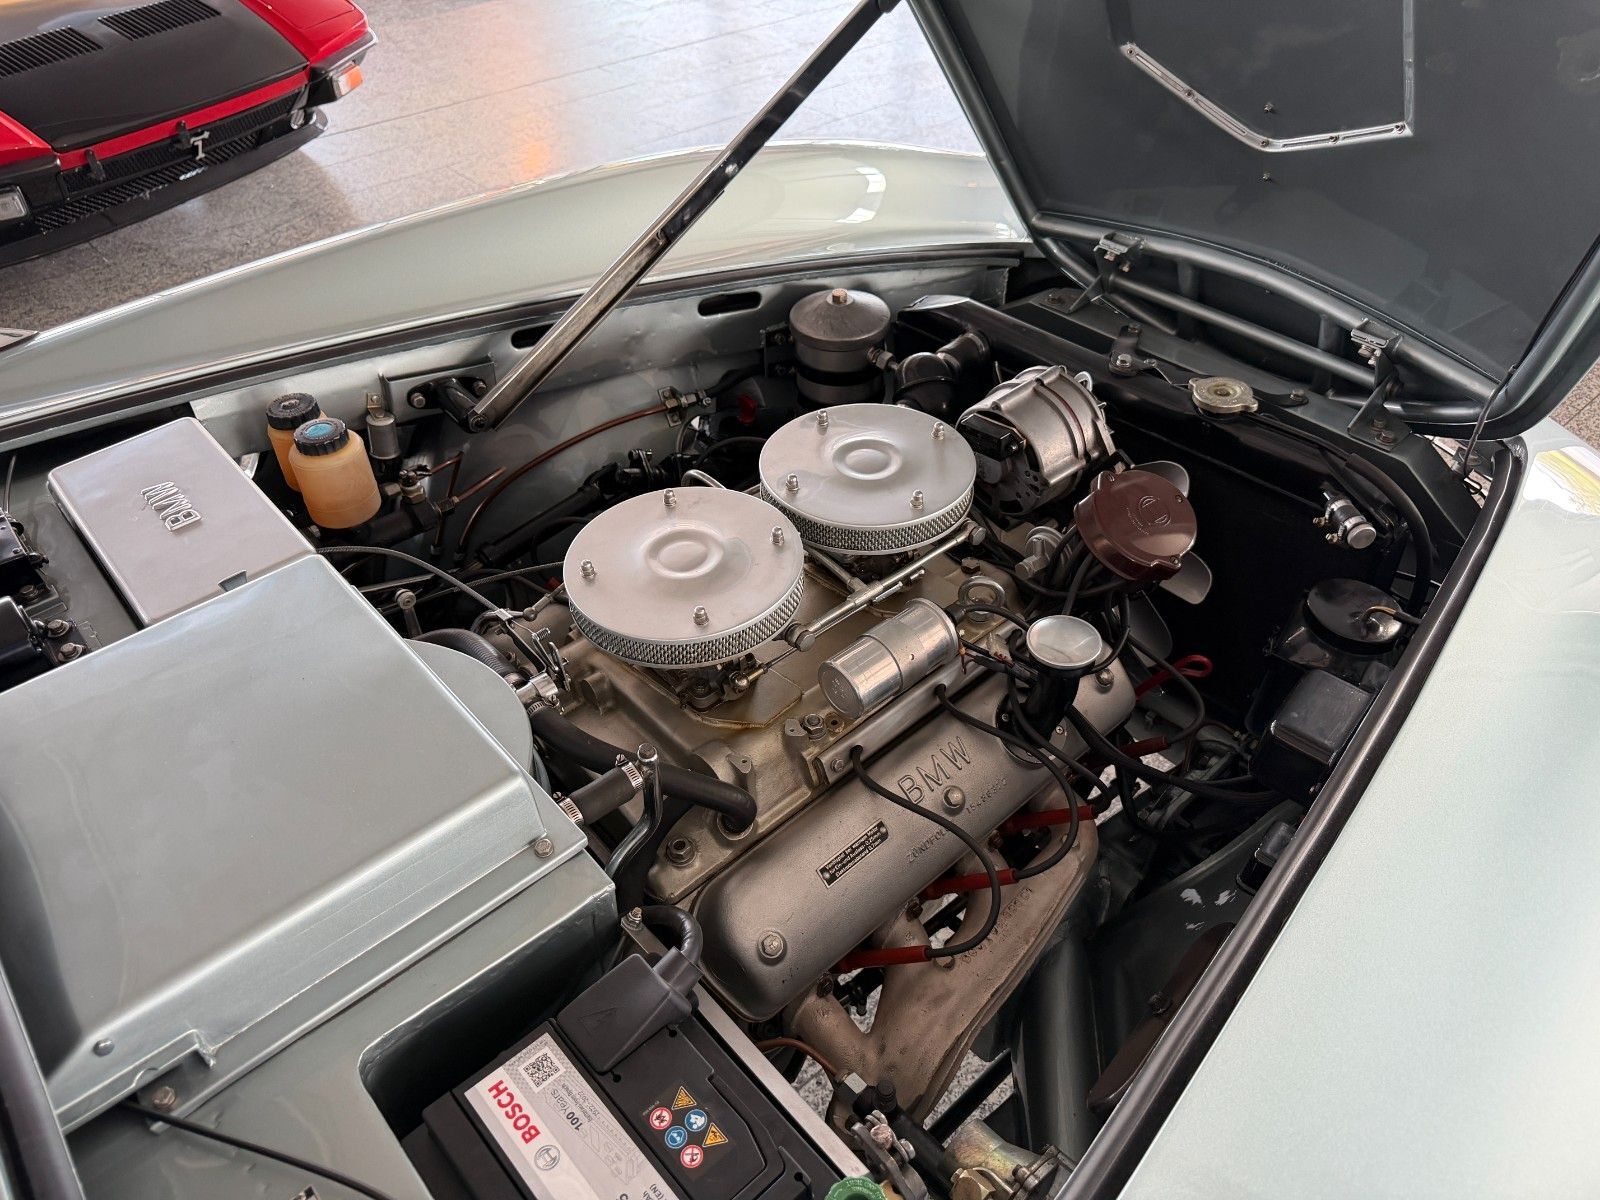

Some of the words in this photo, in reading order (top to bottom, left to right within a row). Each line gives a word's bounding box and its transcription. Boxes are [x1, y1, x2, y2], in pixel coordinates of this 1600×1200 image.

[141, 481, 201, 531] BMW
[898, 736, 971, 805] BMW
[488, 1080, 541, 1144] BOSCH
[550, 1088, 567, 1114] Years
[566, 1111, 583, 1131] 100
